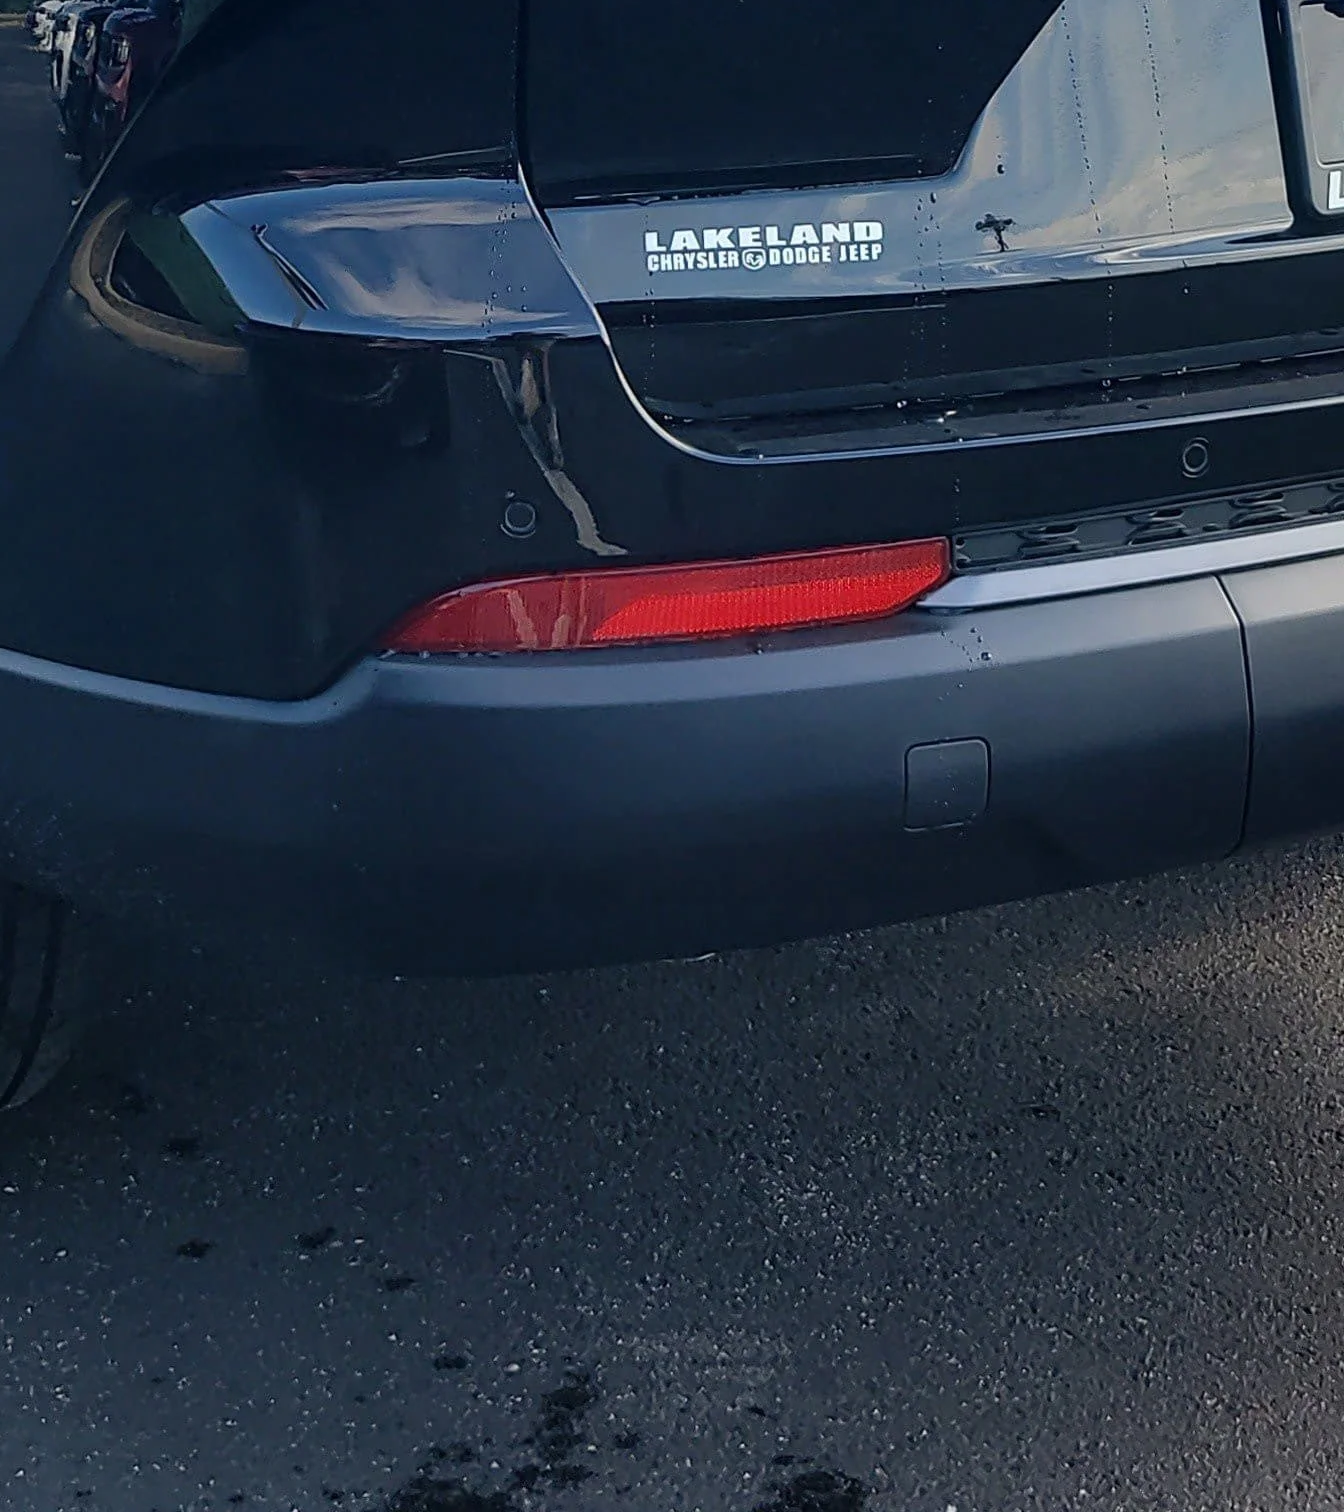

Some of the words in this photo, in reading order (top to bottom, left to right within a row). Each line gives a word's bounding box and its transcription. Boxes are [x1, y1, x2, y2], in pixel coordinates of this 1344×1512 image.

[645, 221, 884, 252] LAKELAND
[647, 250, 740, 271] CHRYSLER
[769, 246, 832, 264] DODGE
[839, 243, 883, 262] JEEP
